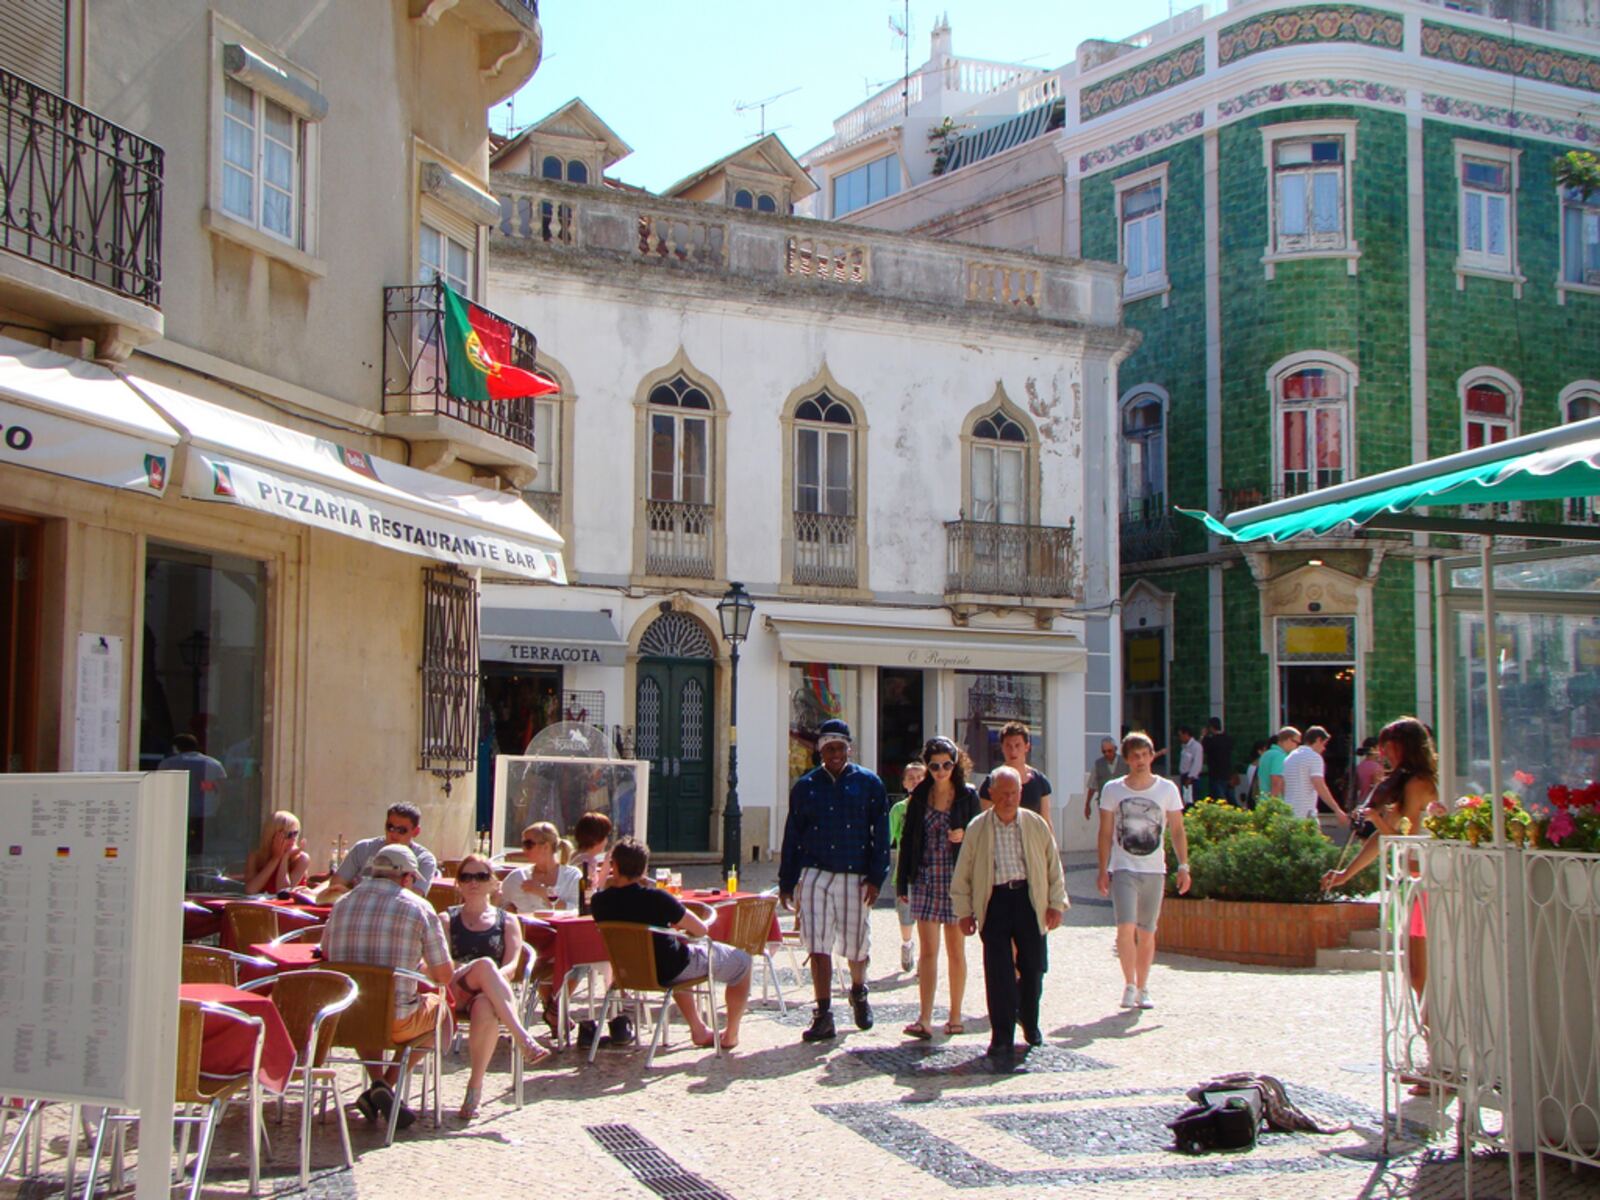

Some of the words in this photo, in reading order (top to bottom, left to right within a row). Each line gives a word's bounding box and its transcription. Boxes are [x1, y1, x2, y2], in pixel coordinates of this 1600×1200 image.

[257, 481, 363, 528] PIZZARIA
[368, 514, 500, 561] RESTAURANTE
[505, 548, 536, 570] BAR
[510, 645, 601, 662] TERRACOTA
